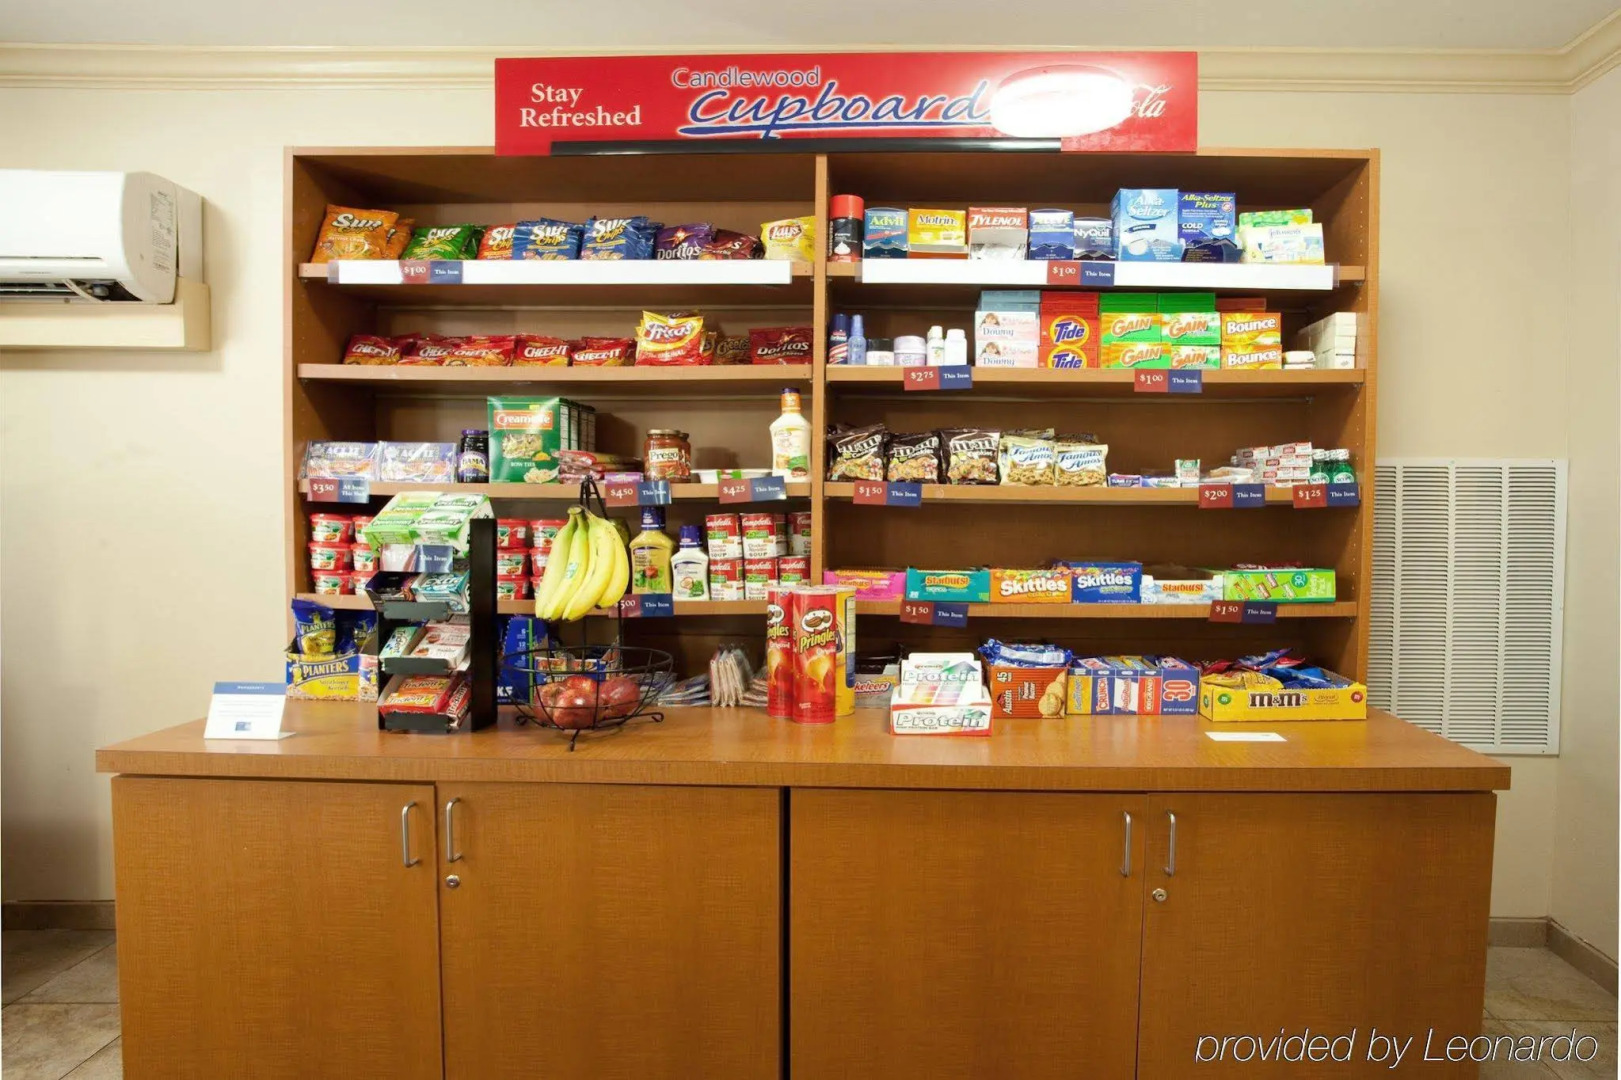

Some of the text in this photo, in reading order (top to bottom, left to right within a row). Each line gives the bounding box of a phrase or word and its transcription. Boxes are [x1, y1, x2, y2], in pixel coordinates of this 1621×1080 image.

[671, 66, 821, 87] Candlewood
[530, 83, 584, 107] Stay
[519, 104, 642, 128] Refreshed
[689, 80, 992, 139] Cupboard
[969, 213, 1023, 227] TYLENOL
[488, 227, 515, 246] Su
[1074, 227, 1110, 239] NyQuil
[434, 268, 448, 276] This
[1055, 321, 1085, 343] Tide
[1111, 317, 1153, 337] GAIN
[1168, 316, 1207, 338] GAIN
[1226, 317, 1276, 335] Bounce
[756, 341, 810, 355] Doritos
[1119, 346, 1162, 367] GAIN
[1052, 353, 1083, 369] Tide
[1171, 352, 1206, 368] GAIN
[1226, 349, 1278, 366] Bounce
[649, 451, 678, 461] Prego
[1059, 451, 1101, 463] Famous
[1066, 458, 1101, 470] Amos
[1000, 579, 1067, 596] Skittles
[1077, 574, 1132, 589] Skittles
[1162, 583, 1204, 592] Starburst
[303, 660, 349, 678] PLANTERS
[902, 670, 980, 683] Protein
[997, 671, 1008, 683] 45
[1098, 679, 1108, 709] CRUNCH
[1163, 680, 1192, 701] 30
[1002, 690, 1013, 715] Austin
[896, 713, 984, 728] Protein
